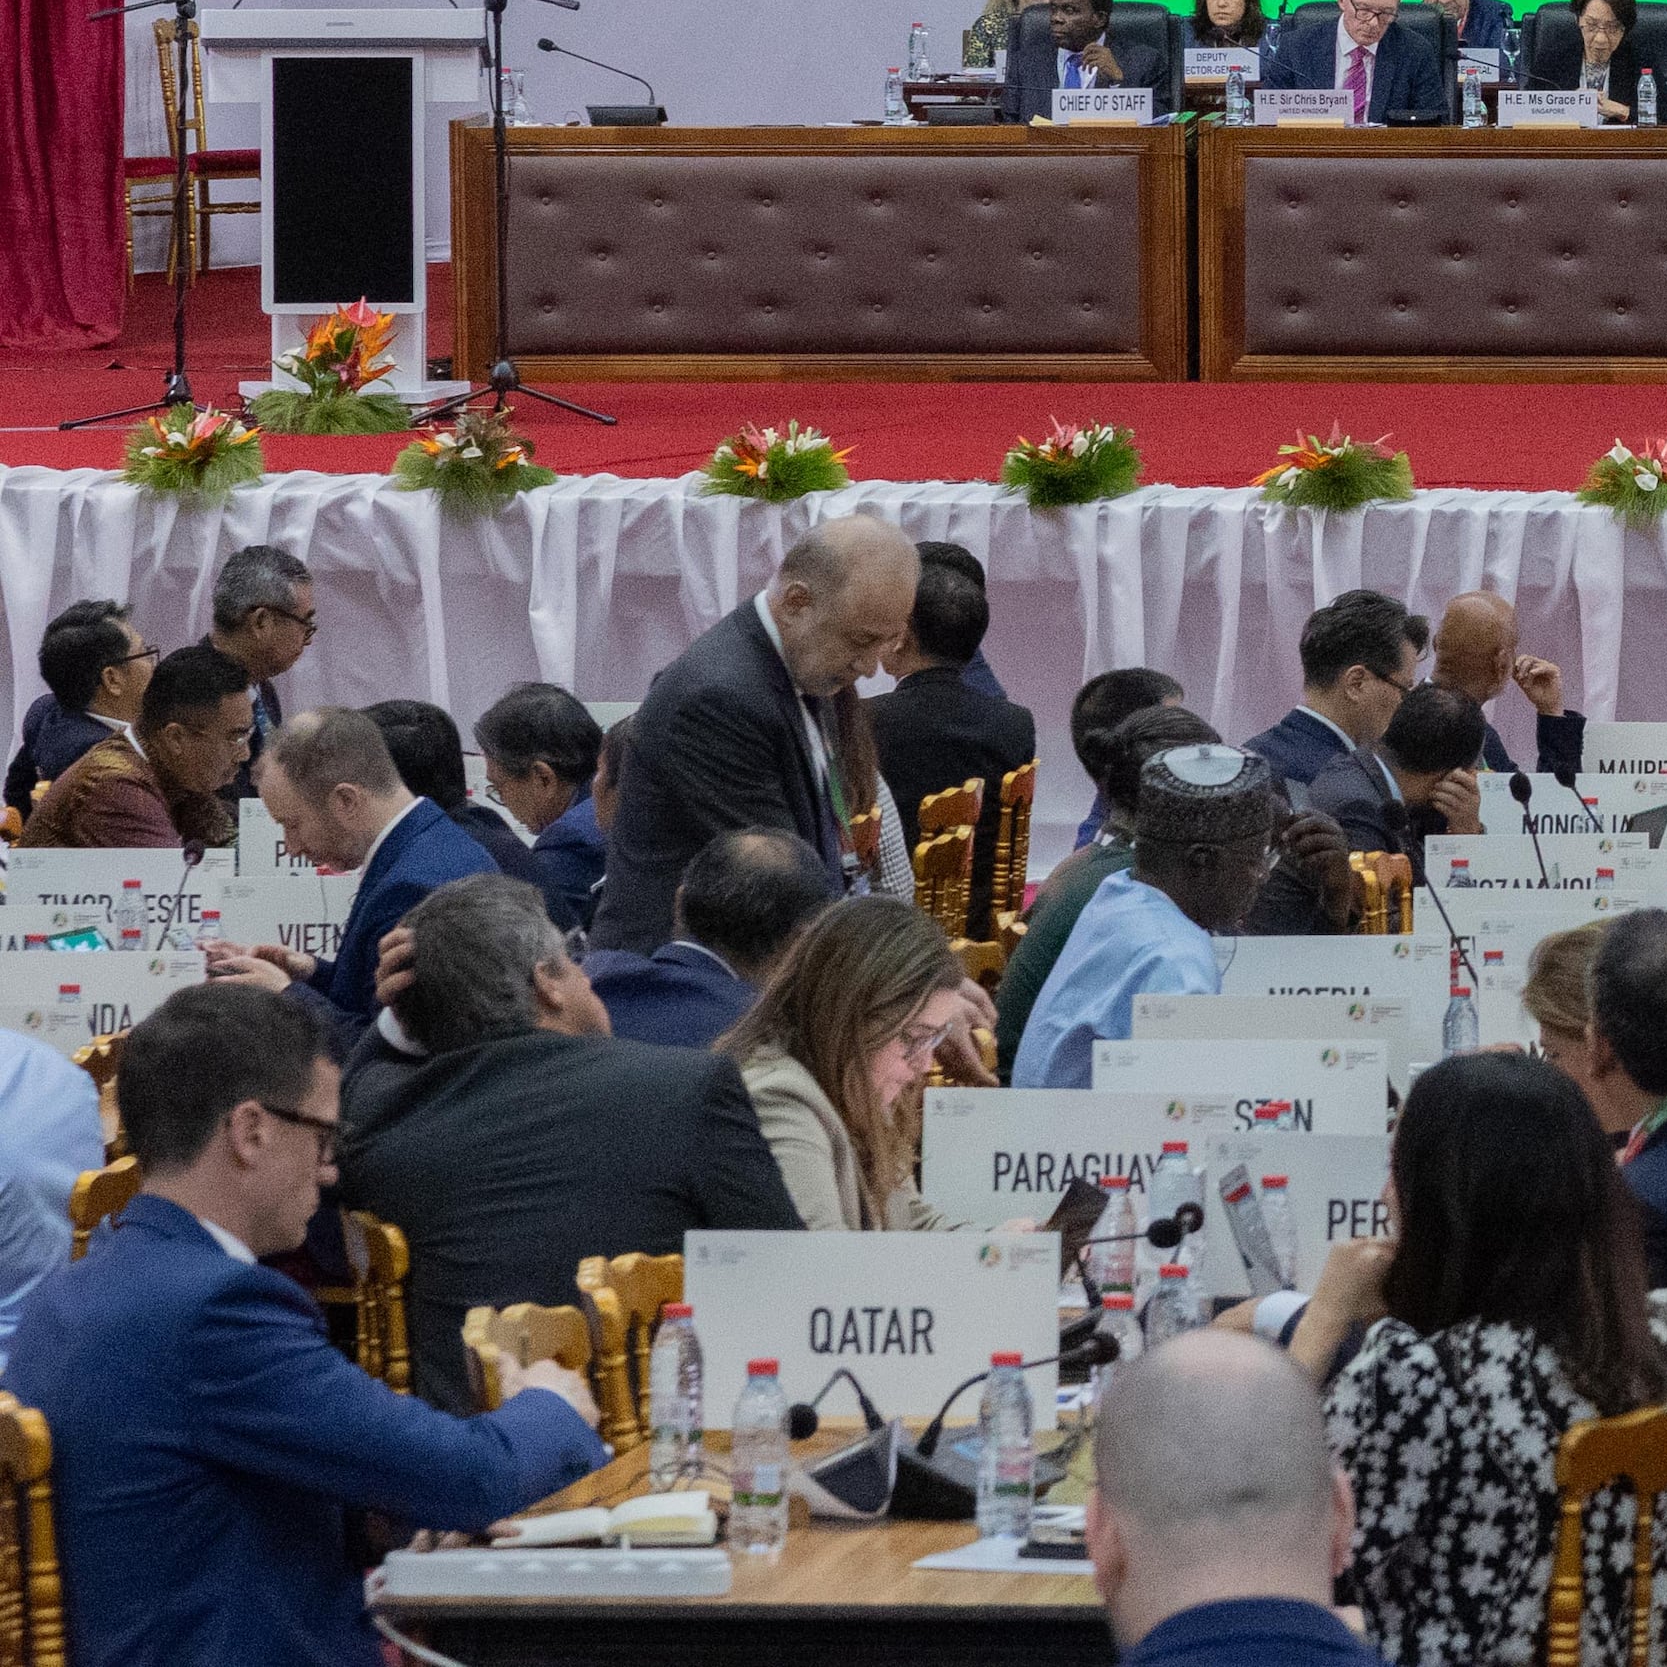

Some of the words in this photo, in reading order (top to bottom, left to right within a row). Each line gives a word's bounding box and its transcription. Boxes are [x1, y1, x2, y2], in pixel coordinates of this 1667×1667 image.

[1196, 52, 1228, 62] DEPUTY
[1060, 96, 1090, 111] CHIEF
[1095, 95, 1108, 111] OF
[1112, 95, 1145, 111] STAFF
[1260, 94, 1277, 105] H.E.
[1279, 94, 1293, 106] Sir
[1294, 94, 1317, 105] Chris
[1318, 94, 1348, 108] Bryant
[1506, 94, 1525, 105] H.E.
[1529, 94, 1543, 105] Ms
[1546, 94, 1576, 105] Grace
[1579, 94, 1591, 105] Fu
[810, 1307, 933, 1354] QATAR
